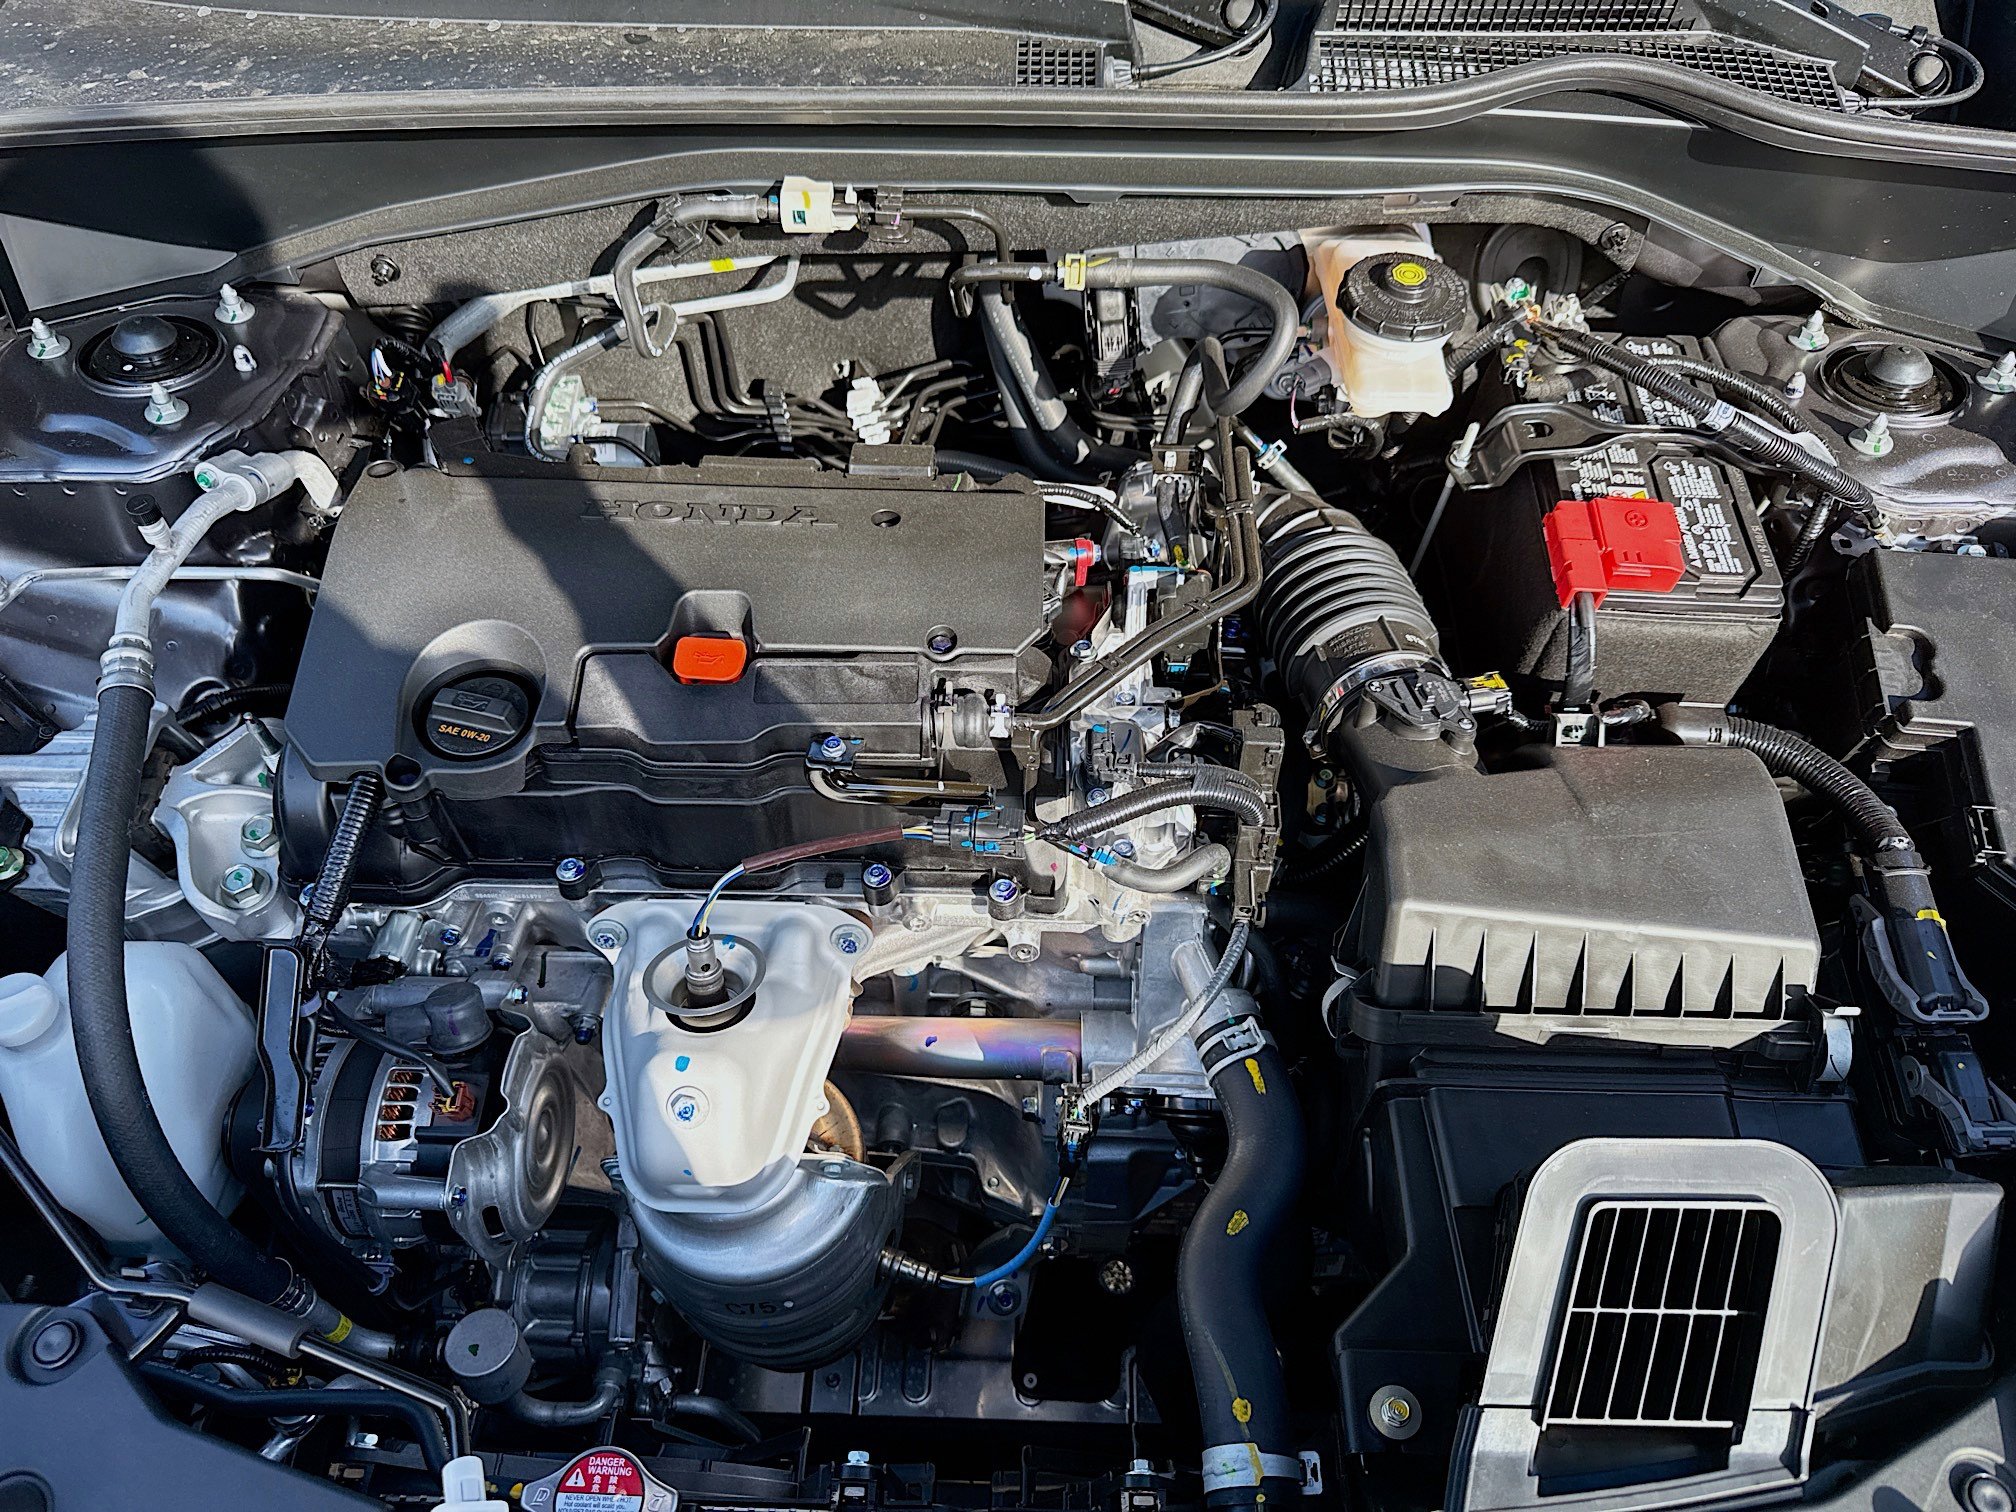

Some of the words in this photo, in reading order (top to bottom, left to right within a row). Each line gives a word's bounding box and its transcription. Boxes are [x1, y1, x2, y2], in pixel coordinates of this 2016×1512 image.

[579, 499, 839, 526] HONDA
[438, 724, 461, 736] SAE
[460, 729, 491, 742] 0W-20
[588, 1456, 626, 1467] DANGER
[587, 1465, 633, 1476] WARNUNG
